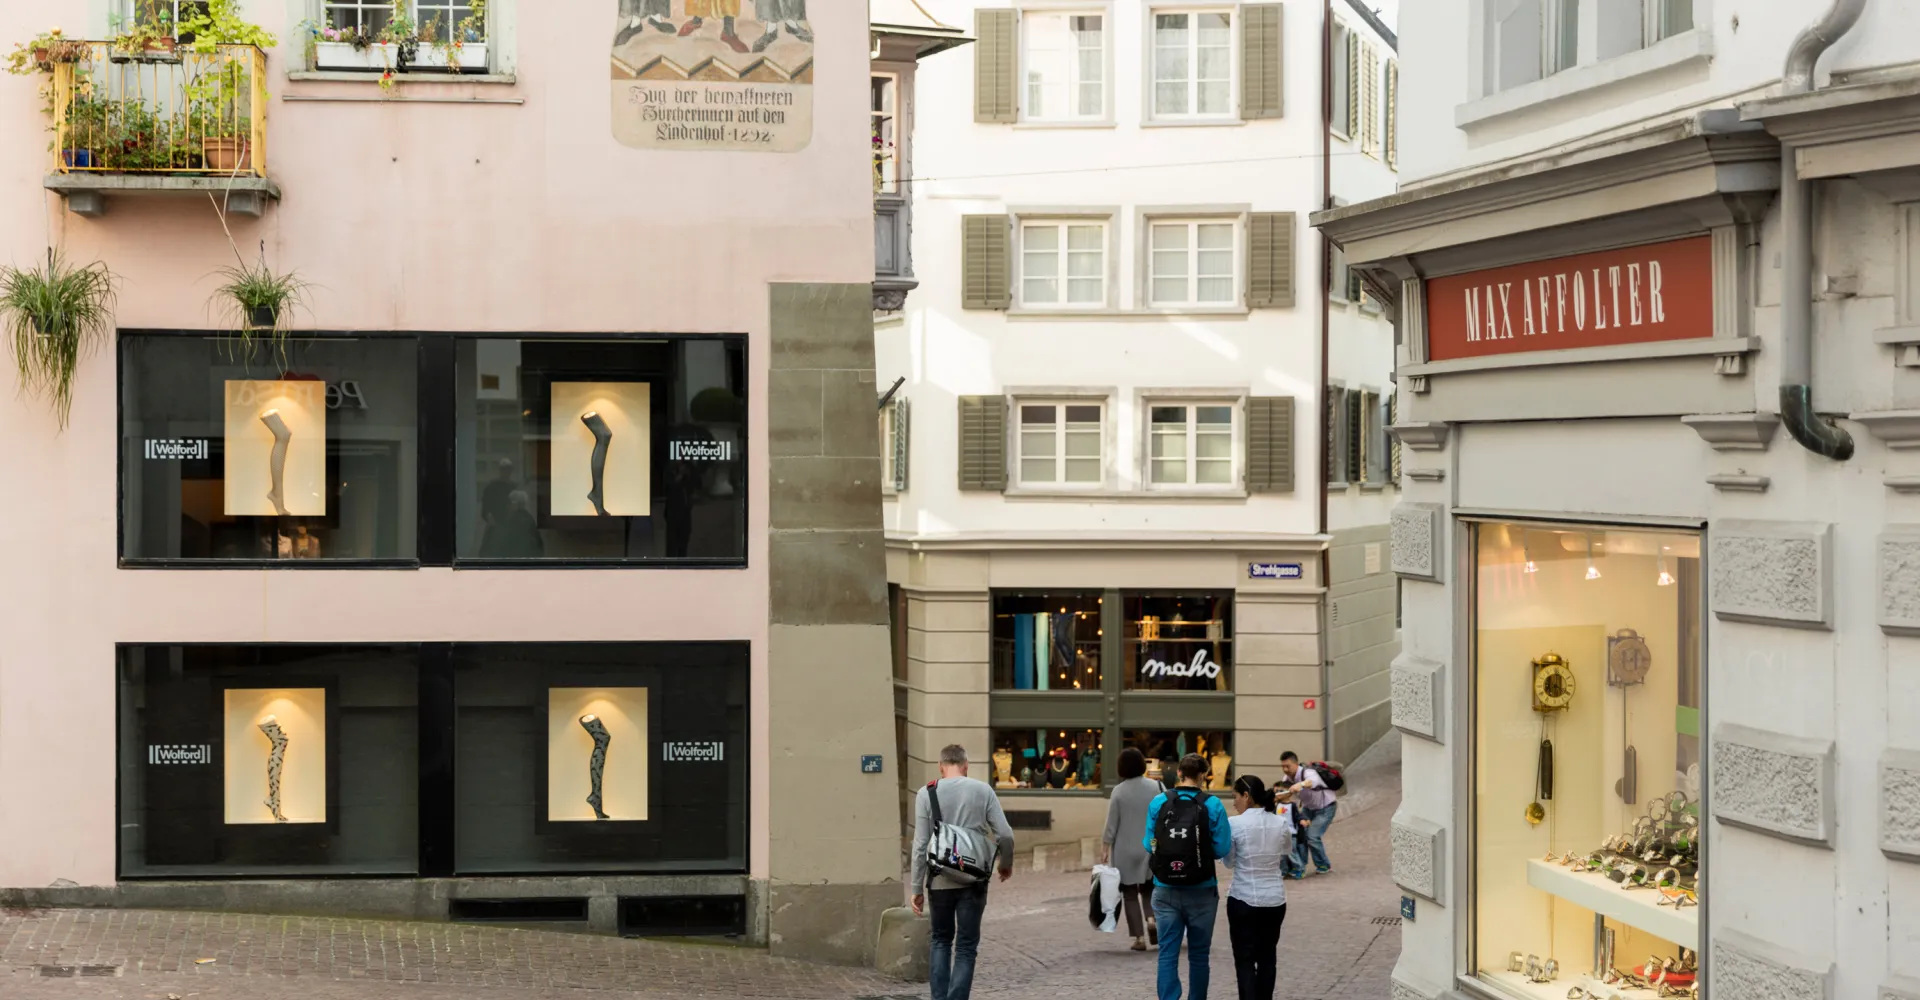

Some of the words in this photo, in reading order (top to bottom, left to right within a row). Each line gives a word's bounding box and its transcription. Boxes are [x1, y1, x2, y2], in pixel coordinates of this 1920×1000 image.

[674, 87, 698, 104] der
[704, 86, 793, 106] bewaffneten
[738, 107, 759, 123] auf
[763, 107, 785, 124] den
[656, 122, 725, 144] Lindenhof
[1464, 282, 1514, 342] MAX
[1523, 260, 1665, 335] AFFOLTER
[155, 444, 198, 455] Wolford
[680, 445, 721, 456] Wolford
[1140, 648, 1221, 679] maho
[159, 749, 201, 760] Wolford
[673, 746, 714, 757] Wolford
